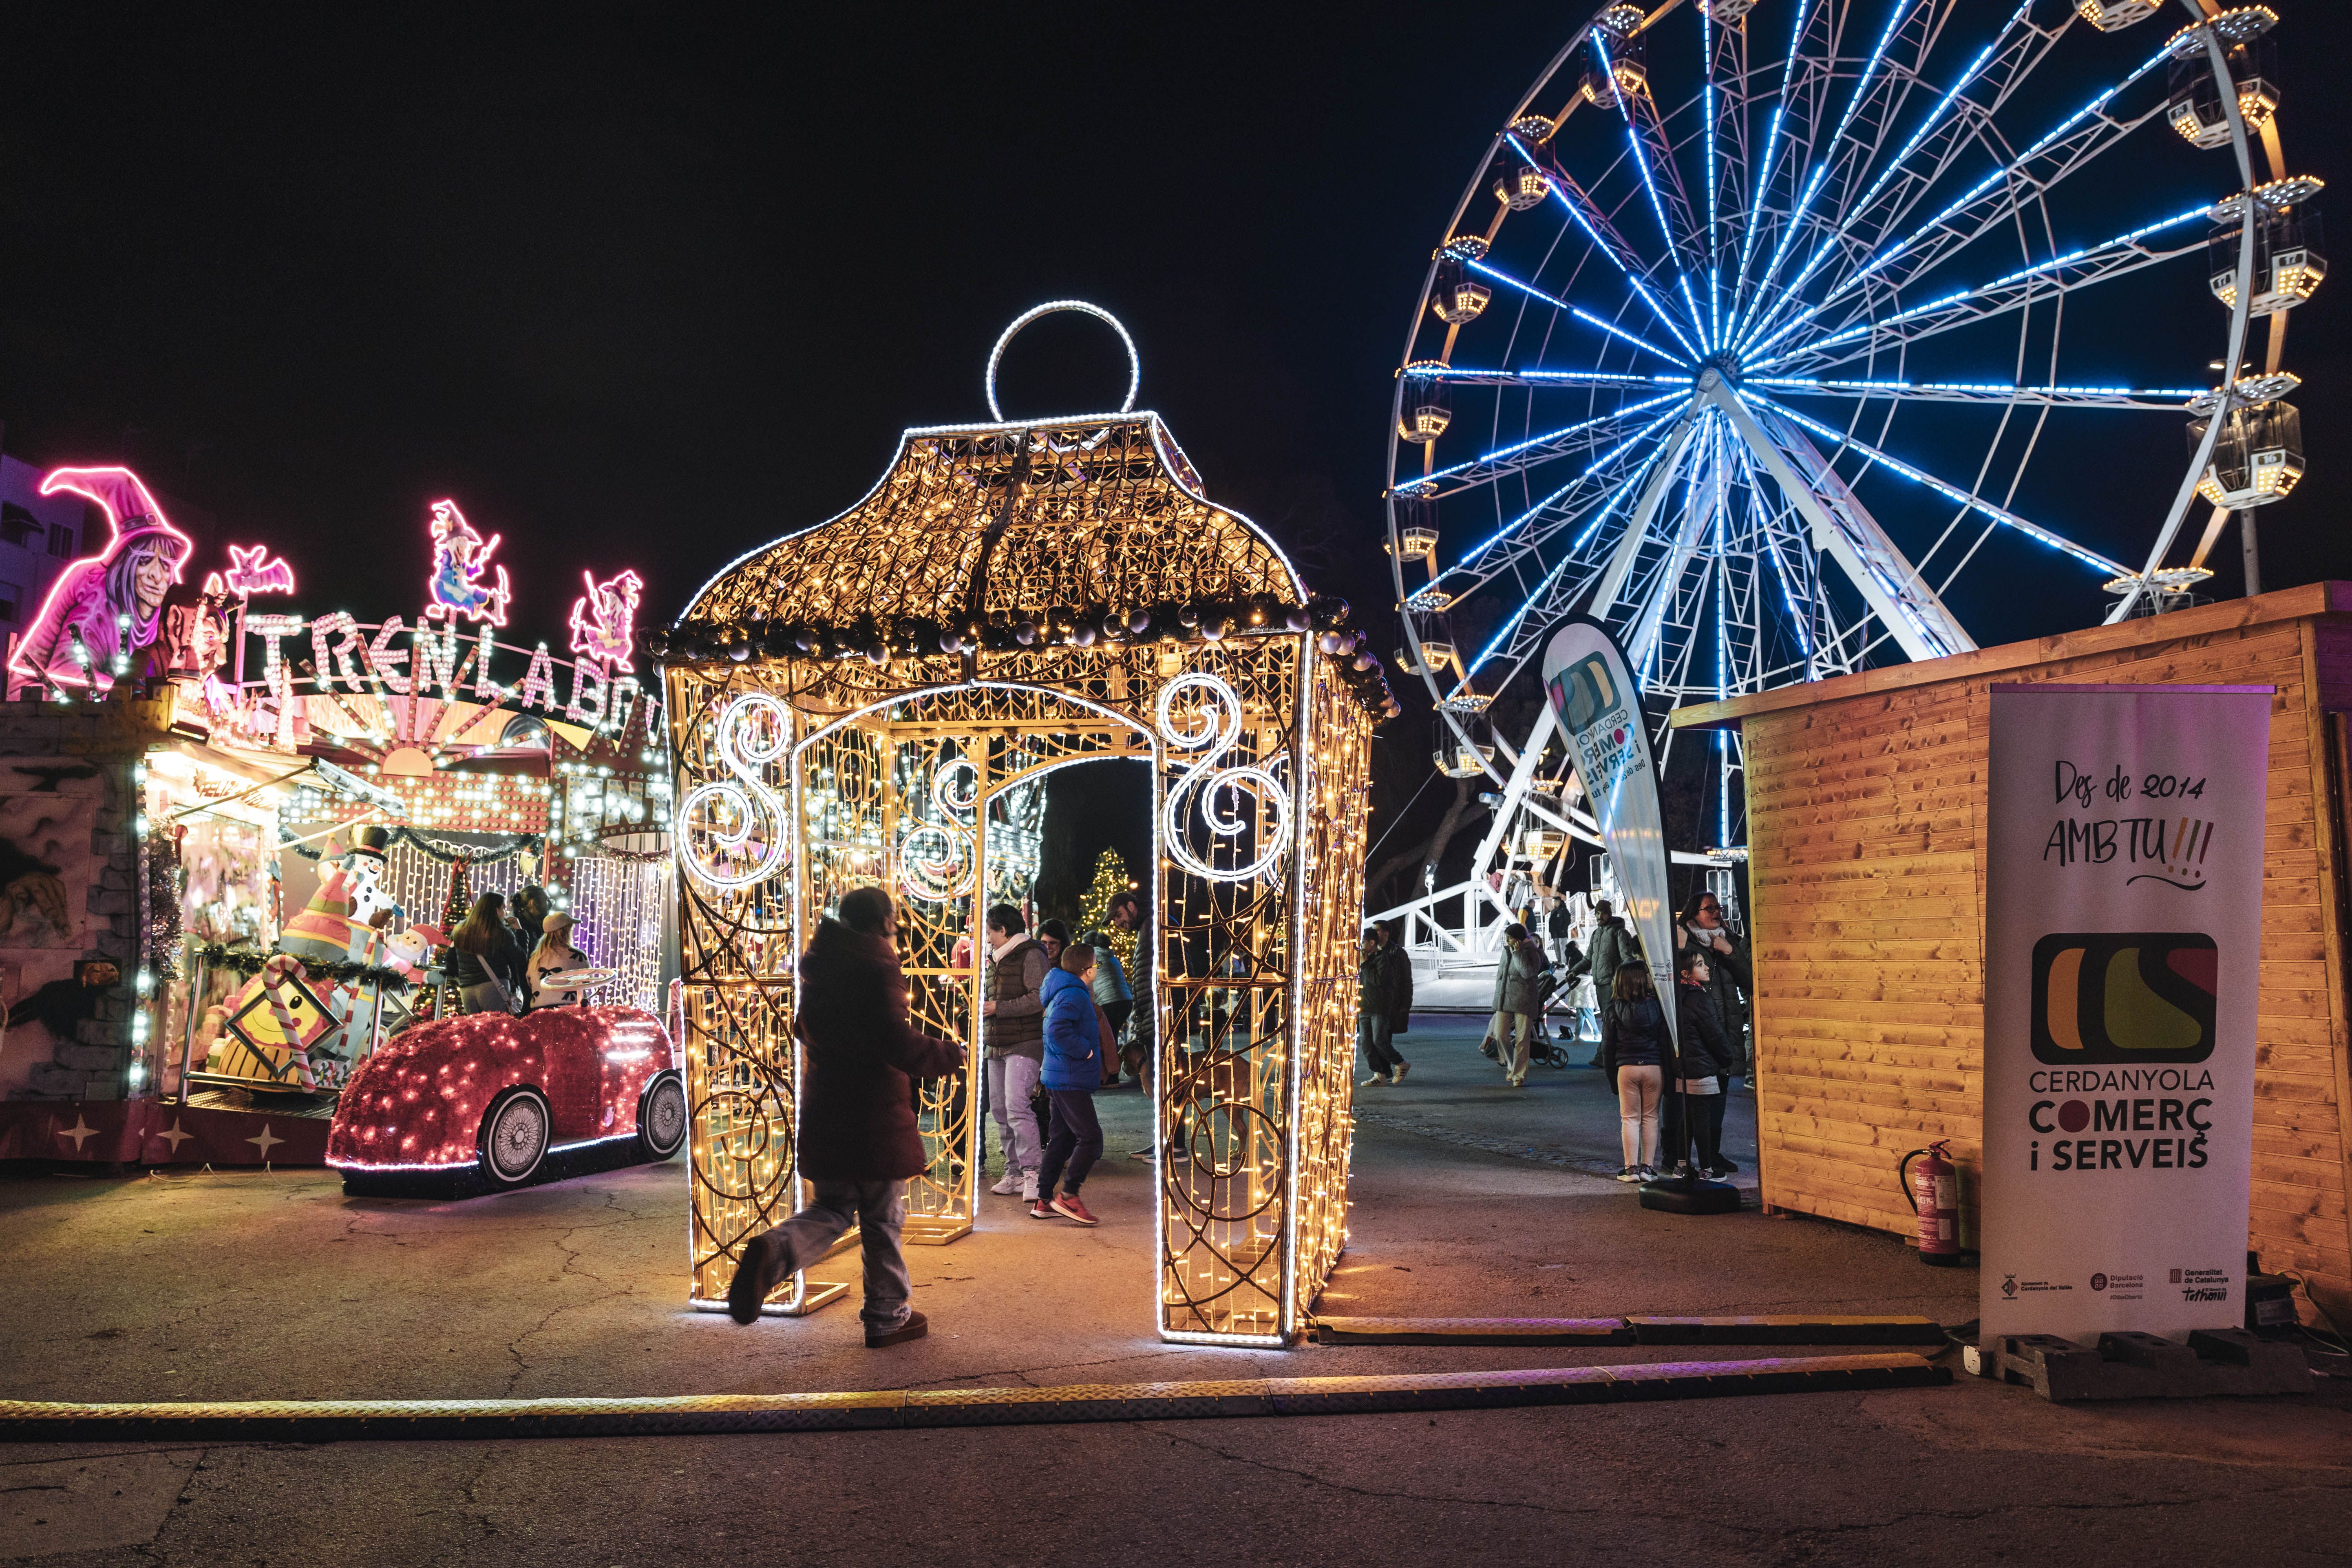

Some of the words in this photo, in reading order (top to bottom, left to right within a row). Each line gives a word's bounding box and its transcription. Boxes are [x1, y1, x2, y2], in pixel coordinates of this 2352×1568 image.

[2285, 254, 2296, 264] 17
[2218, 276, 2226, 287] 17
[2264, 455, 2277, 464] 16
[244, 611, 456, 698] TREN
[2055, 760, 2097, 808] Des
[2106, 764, 2131, 802] de
[2140, 774, 2206, 799] 2014
[2029, 1069, 2215, 1093] CERDANYOLA
[2029, 1098, 2213, 1139] COMERÇ
[2030, 1141, 2038, 1171] i
[2052, 1139, 2208, 1171] SERVEIS
